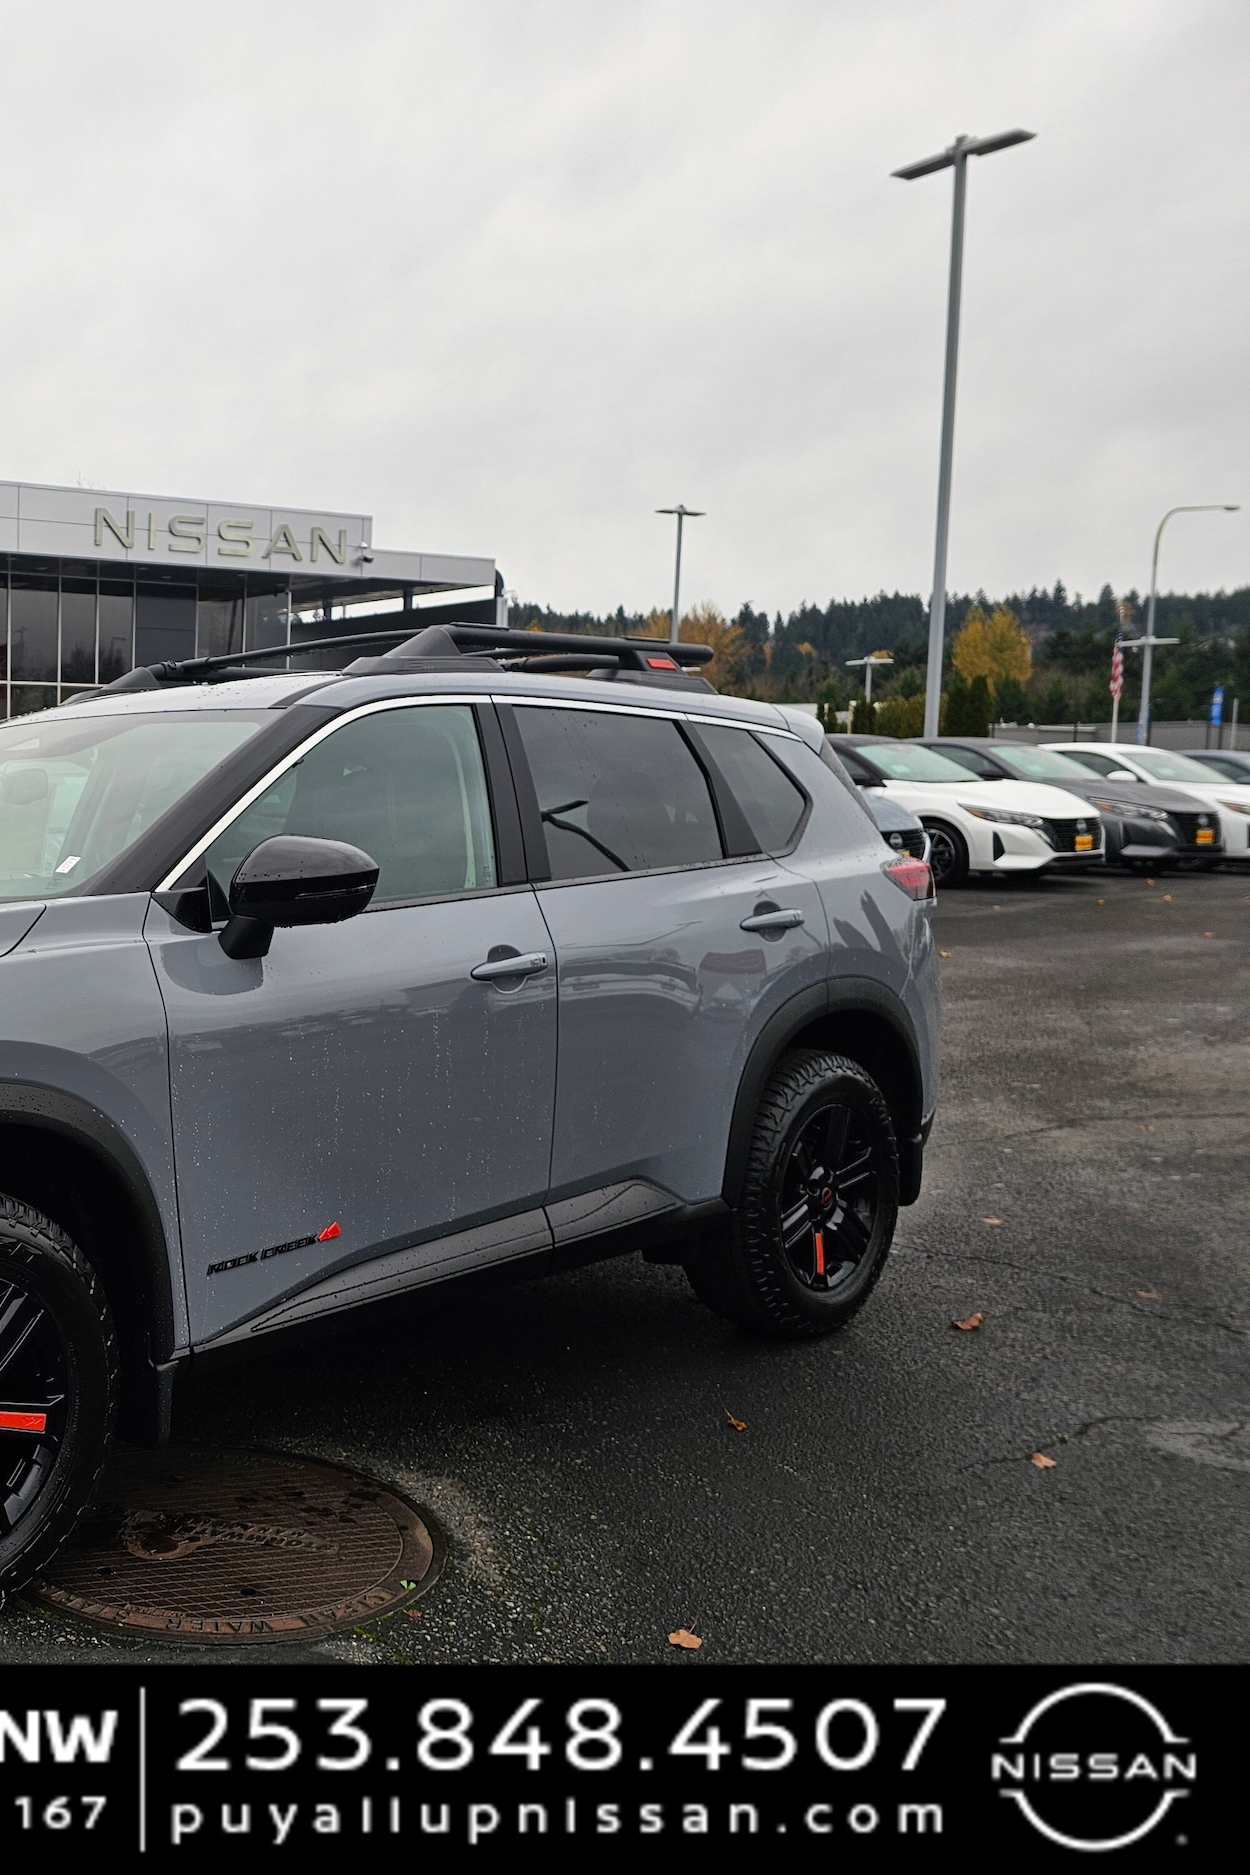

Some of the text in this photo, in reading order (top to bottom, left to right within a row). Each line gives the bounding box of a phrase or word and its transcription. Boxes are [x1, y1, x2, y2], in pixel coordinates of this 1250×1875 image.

[95, 507, 347, 564] NISSAN
[206, 1234, 317, 1276] ROCK CREEK
